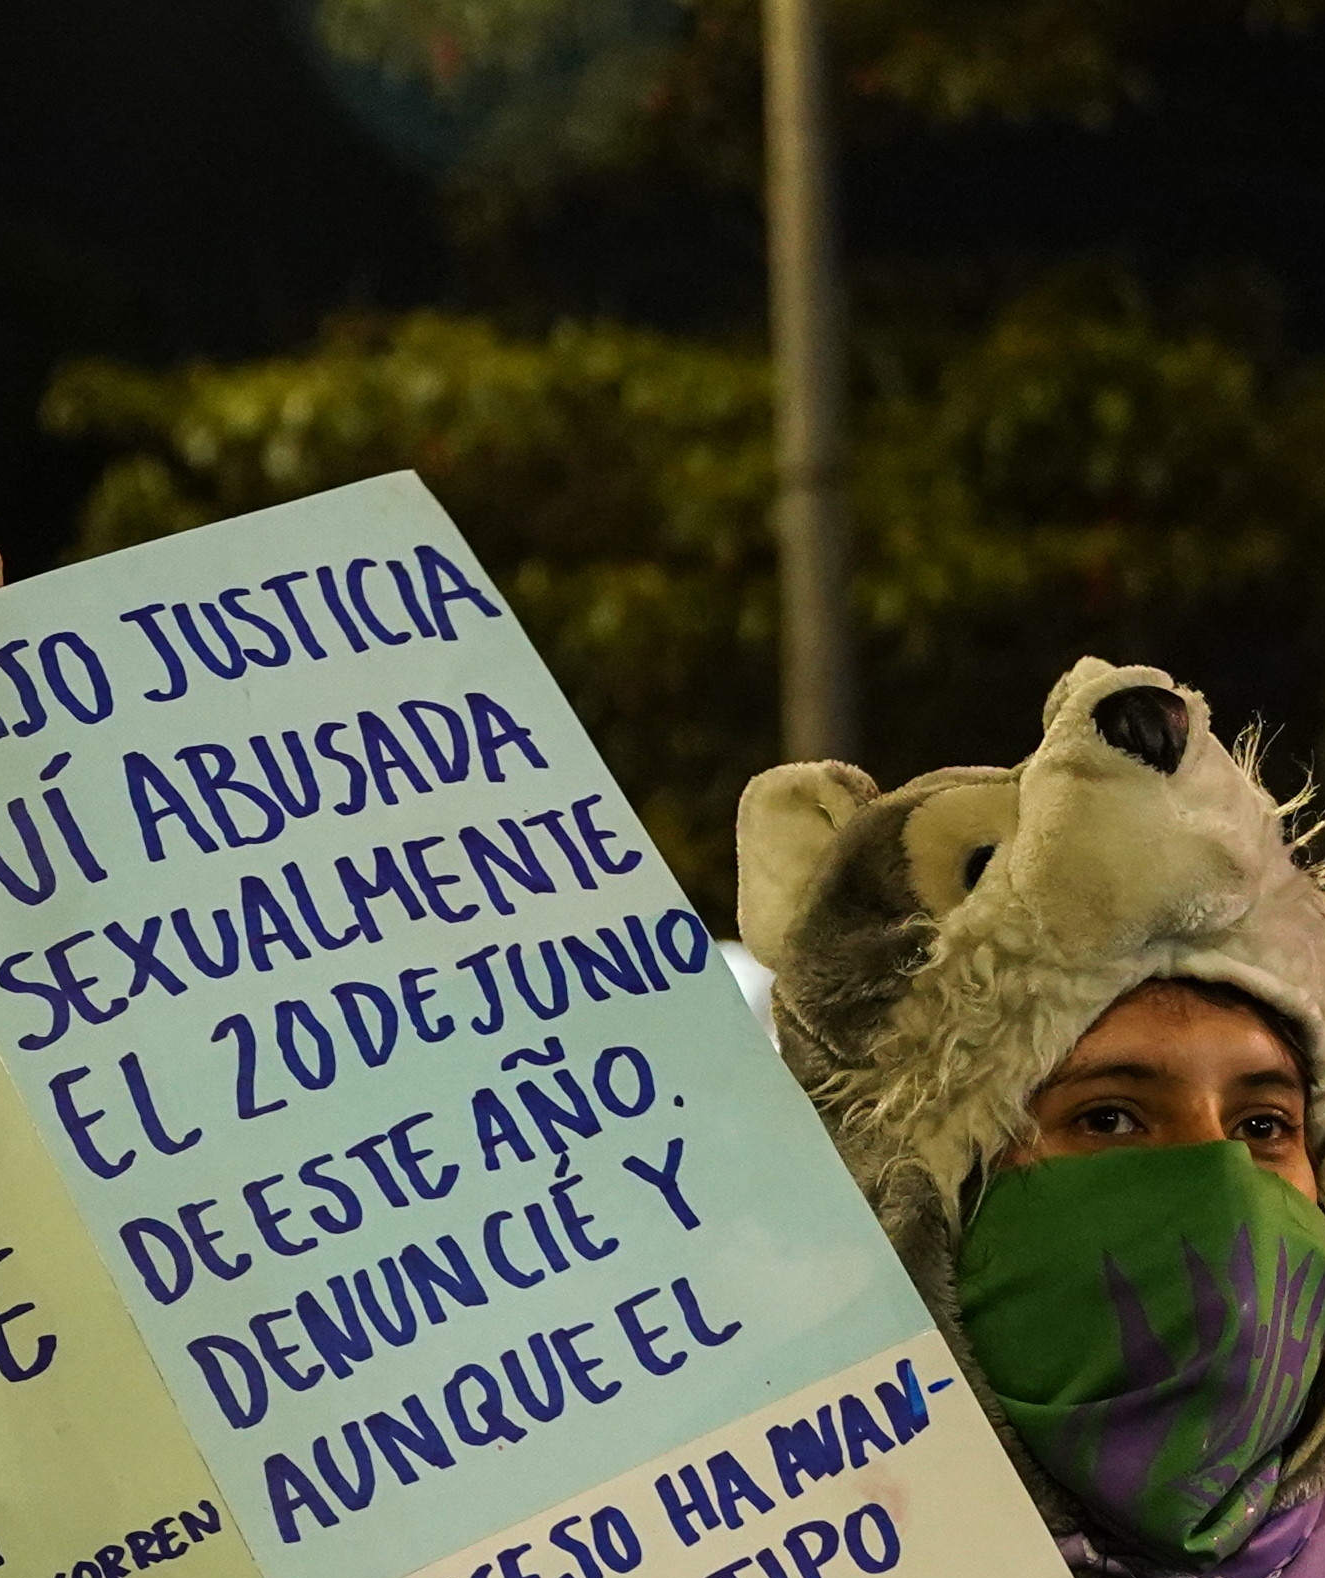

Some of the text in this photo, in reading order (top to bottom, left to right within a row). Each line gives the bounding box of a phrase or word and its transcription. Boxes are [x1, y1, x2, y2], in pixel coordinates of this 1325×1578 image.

[117, 543, 503, 704] JUSTICIA
[120, 691, 549, 864] ABUSADA
[46, 1050, 204, 1181] EL
[469, 1034, 686, 1173] AÑO.
[184, 1136, 702, 1431] DENUNCIÉ Y
[261, 1275, 743, 1545] AUNQUE EL
[652, 1449, 777, 1548] HA
